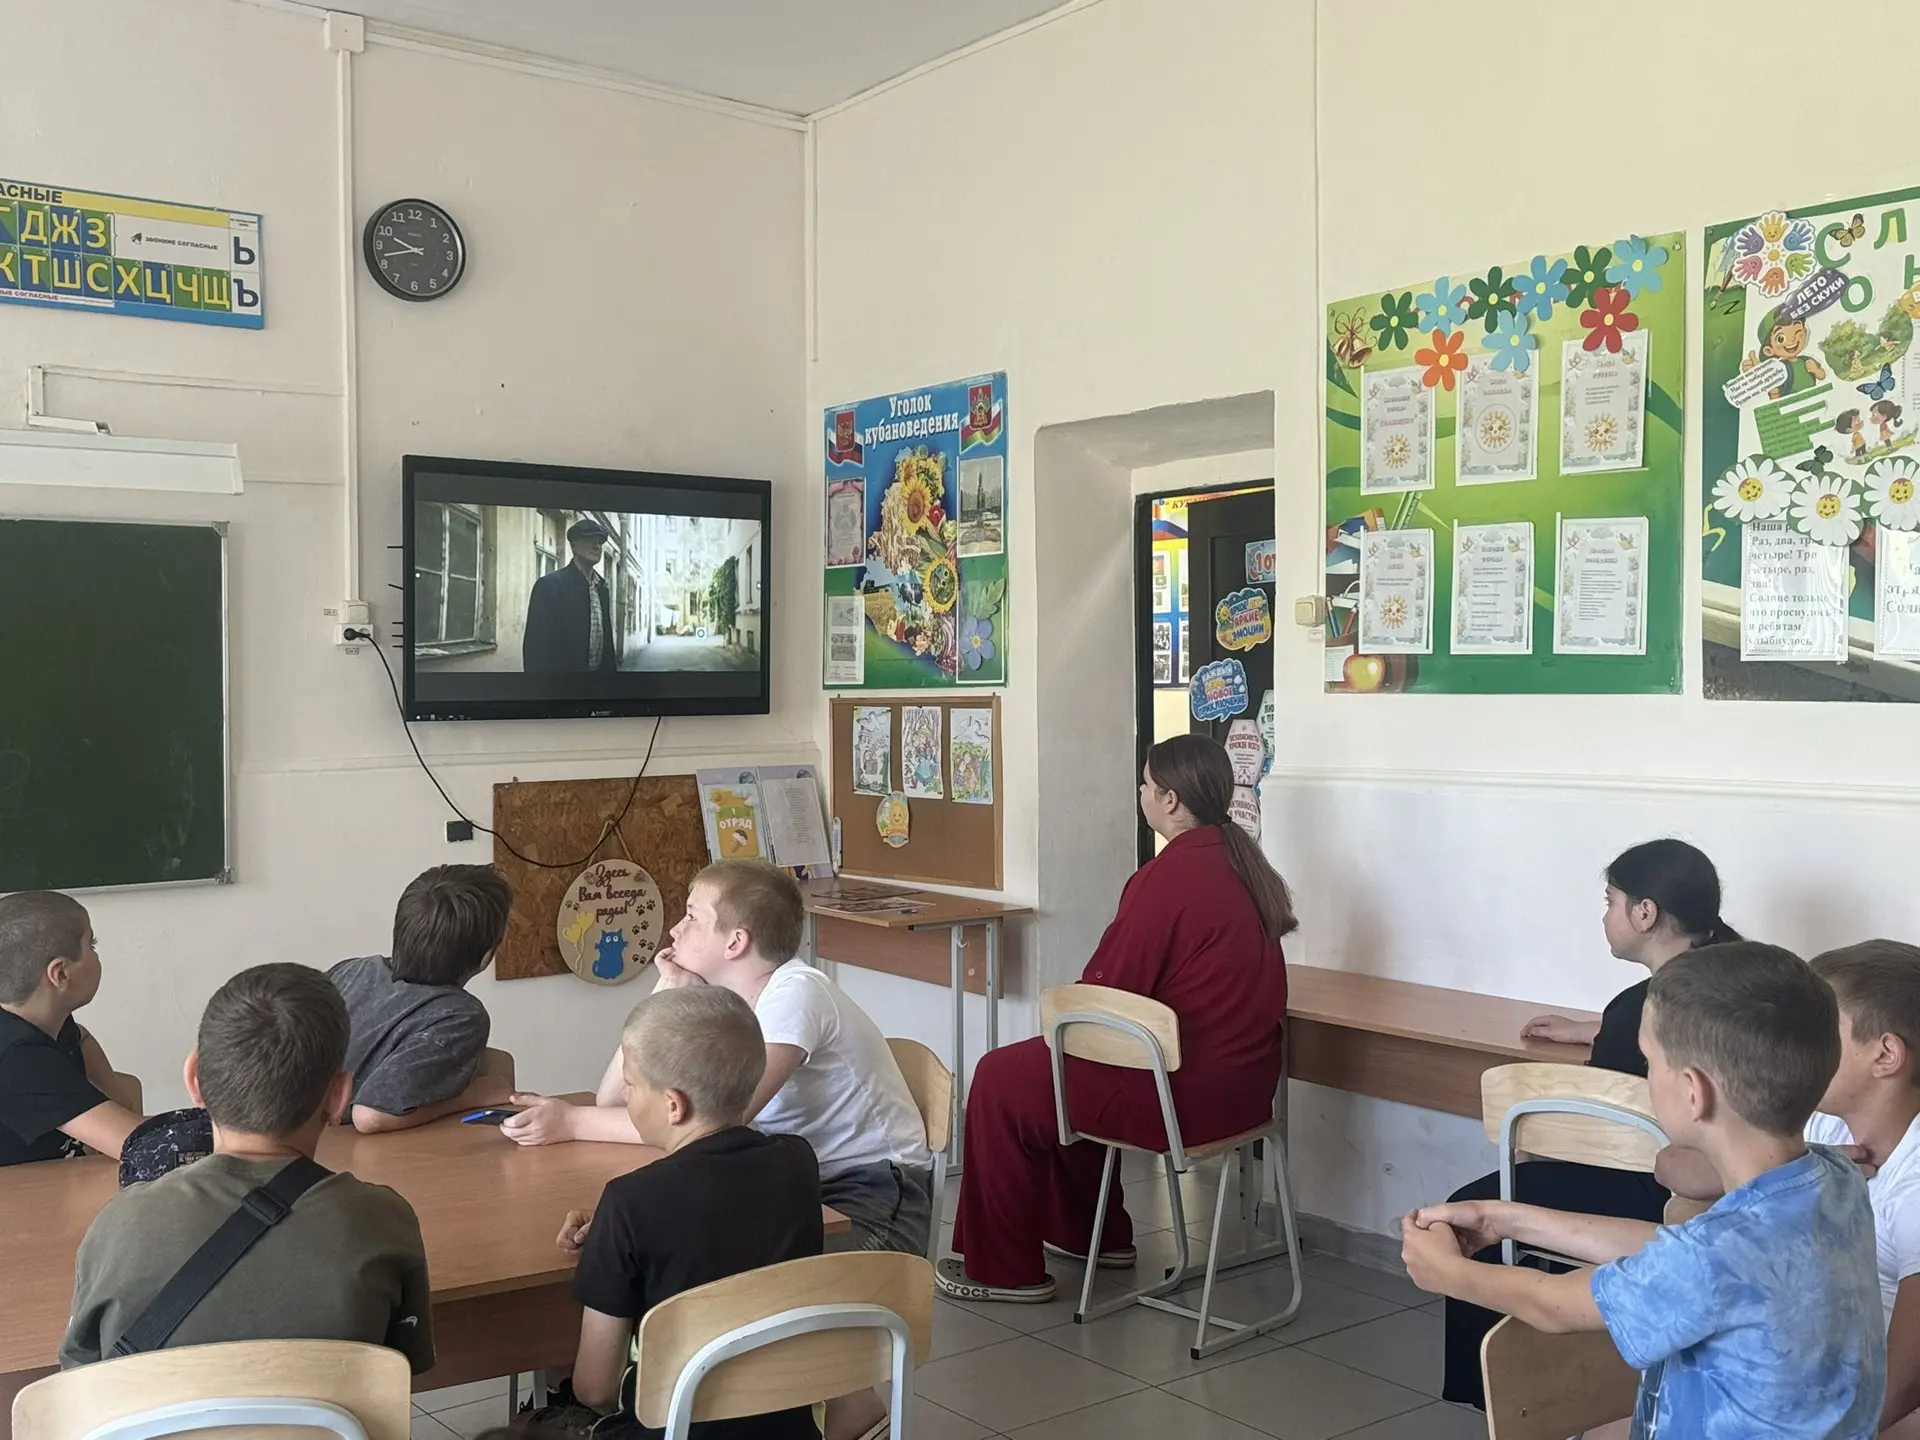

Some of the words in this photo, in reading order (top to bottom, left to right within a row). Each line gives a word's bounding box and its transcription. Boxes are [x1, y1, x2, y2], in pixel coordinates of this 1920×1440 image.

[392, 212, 405, 223] 11
[408, 210, 422, 220] 12
[430, 218, 437, 228] 1
[1873, 207, 1908, 250] Л
[21, 210, 47, 245] Д
[51, 214, 80, 245] Ж
[86, 219, 106, 248] З
[379, 226, 393, 236] 10
[443, 234, 450, 243] 2
[177, 240, 218, 250] СОГЛАСНЫЕ
[233, 236, 256, 264] Ь
[376, 241, 383, 250] 9
[446, 251, 453, 260] 3
[380, 260, 388, 269] 8
[393, 273, 400, 283] 7
[442, 269, 449, 278] 4
[23, 254, 46, 285] Т
[53, 257, 81, 289] Ш
[86, 263, 109, 292] С
[116, 265, 140, 296] Х
[145, 268, 171, 304] Ц
[176, 272, 198, 302] Ч
[203, 275, 230, 310] Щ
[410, 281, 418, 291] 6
[429, 279, 437, 288] 5
[14, 291, 59, 300] СОГЛАСНЫЕ
[233, 278, 259, 307] Ъ
[1796, 276, 1827, 305] ЛЕТО
[1790, 302, 1811, 319] БЕЗ
[1811, 277, 1845, 306] СКУКИ
[888, 393, 932, 420] Уголок
[864, 411, 960, 450] кубановедения
[1753, 522, 1782, 532] Наша
[1752, 536, 1772, 547] Раз,
[1751, 550, 1793, 562] четыре!
[1232, 623, 1264, 641] ЭМОЦИИ
[1207, 687, 1233, 701] НОВОЕ
[719, 817, 753, 830] ОТРЯД
[579, 886, 602, 902] Вам
[945, 1281, 990, 1298] crocs
